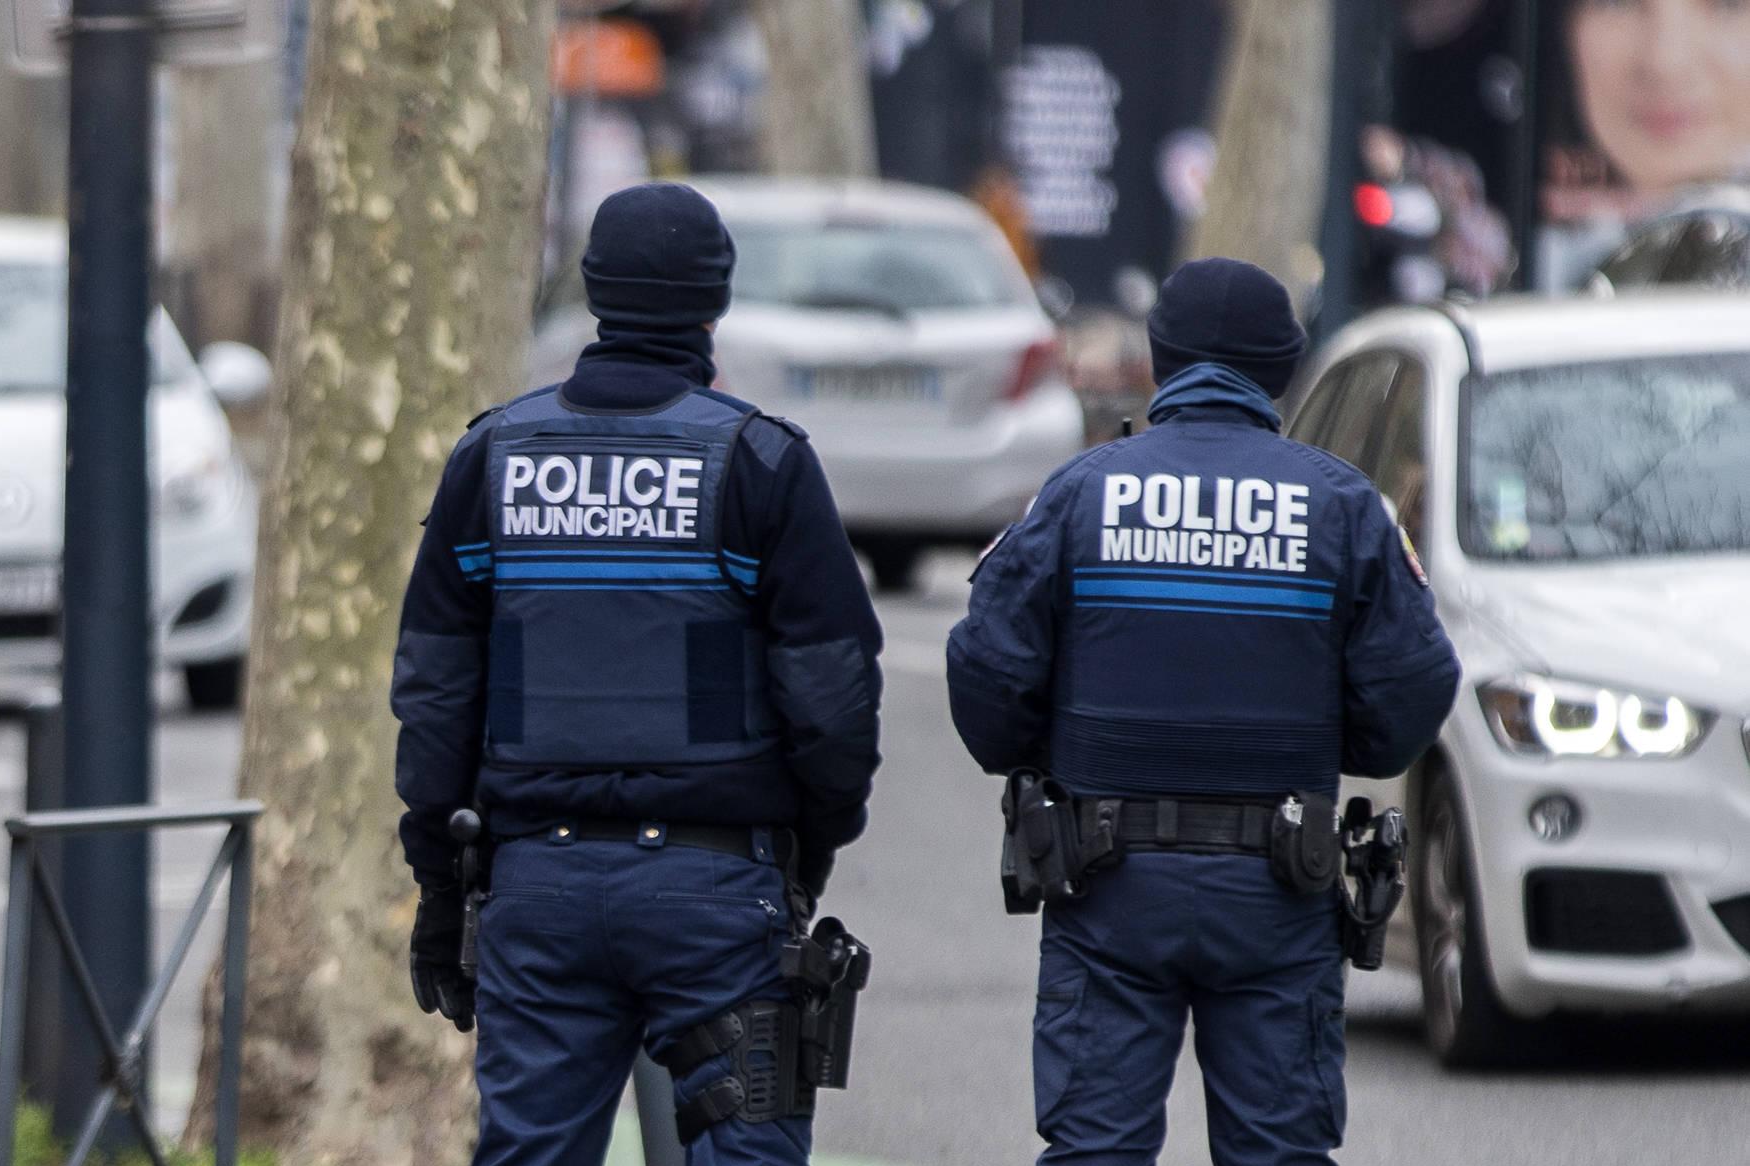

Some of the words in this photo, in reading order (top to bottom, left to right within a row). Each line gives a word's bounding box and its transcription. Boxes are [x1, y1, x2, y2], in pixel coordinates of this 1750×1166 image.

[503, 455, 704, 507] POLICE
[1102, 473, 1310, 537] POLICE
[503, 506, 698, 538] MUNICIPALE
[1102, 528, 1308, 572] MUNICIPALE
